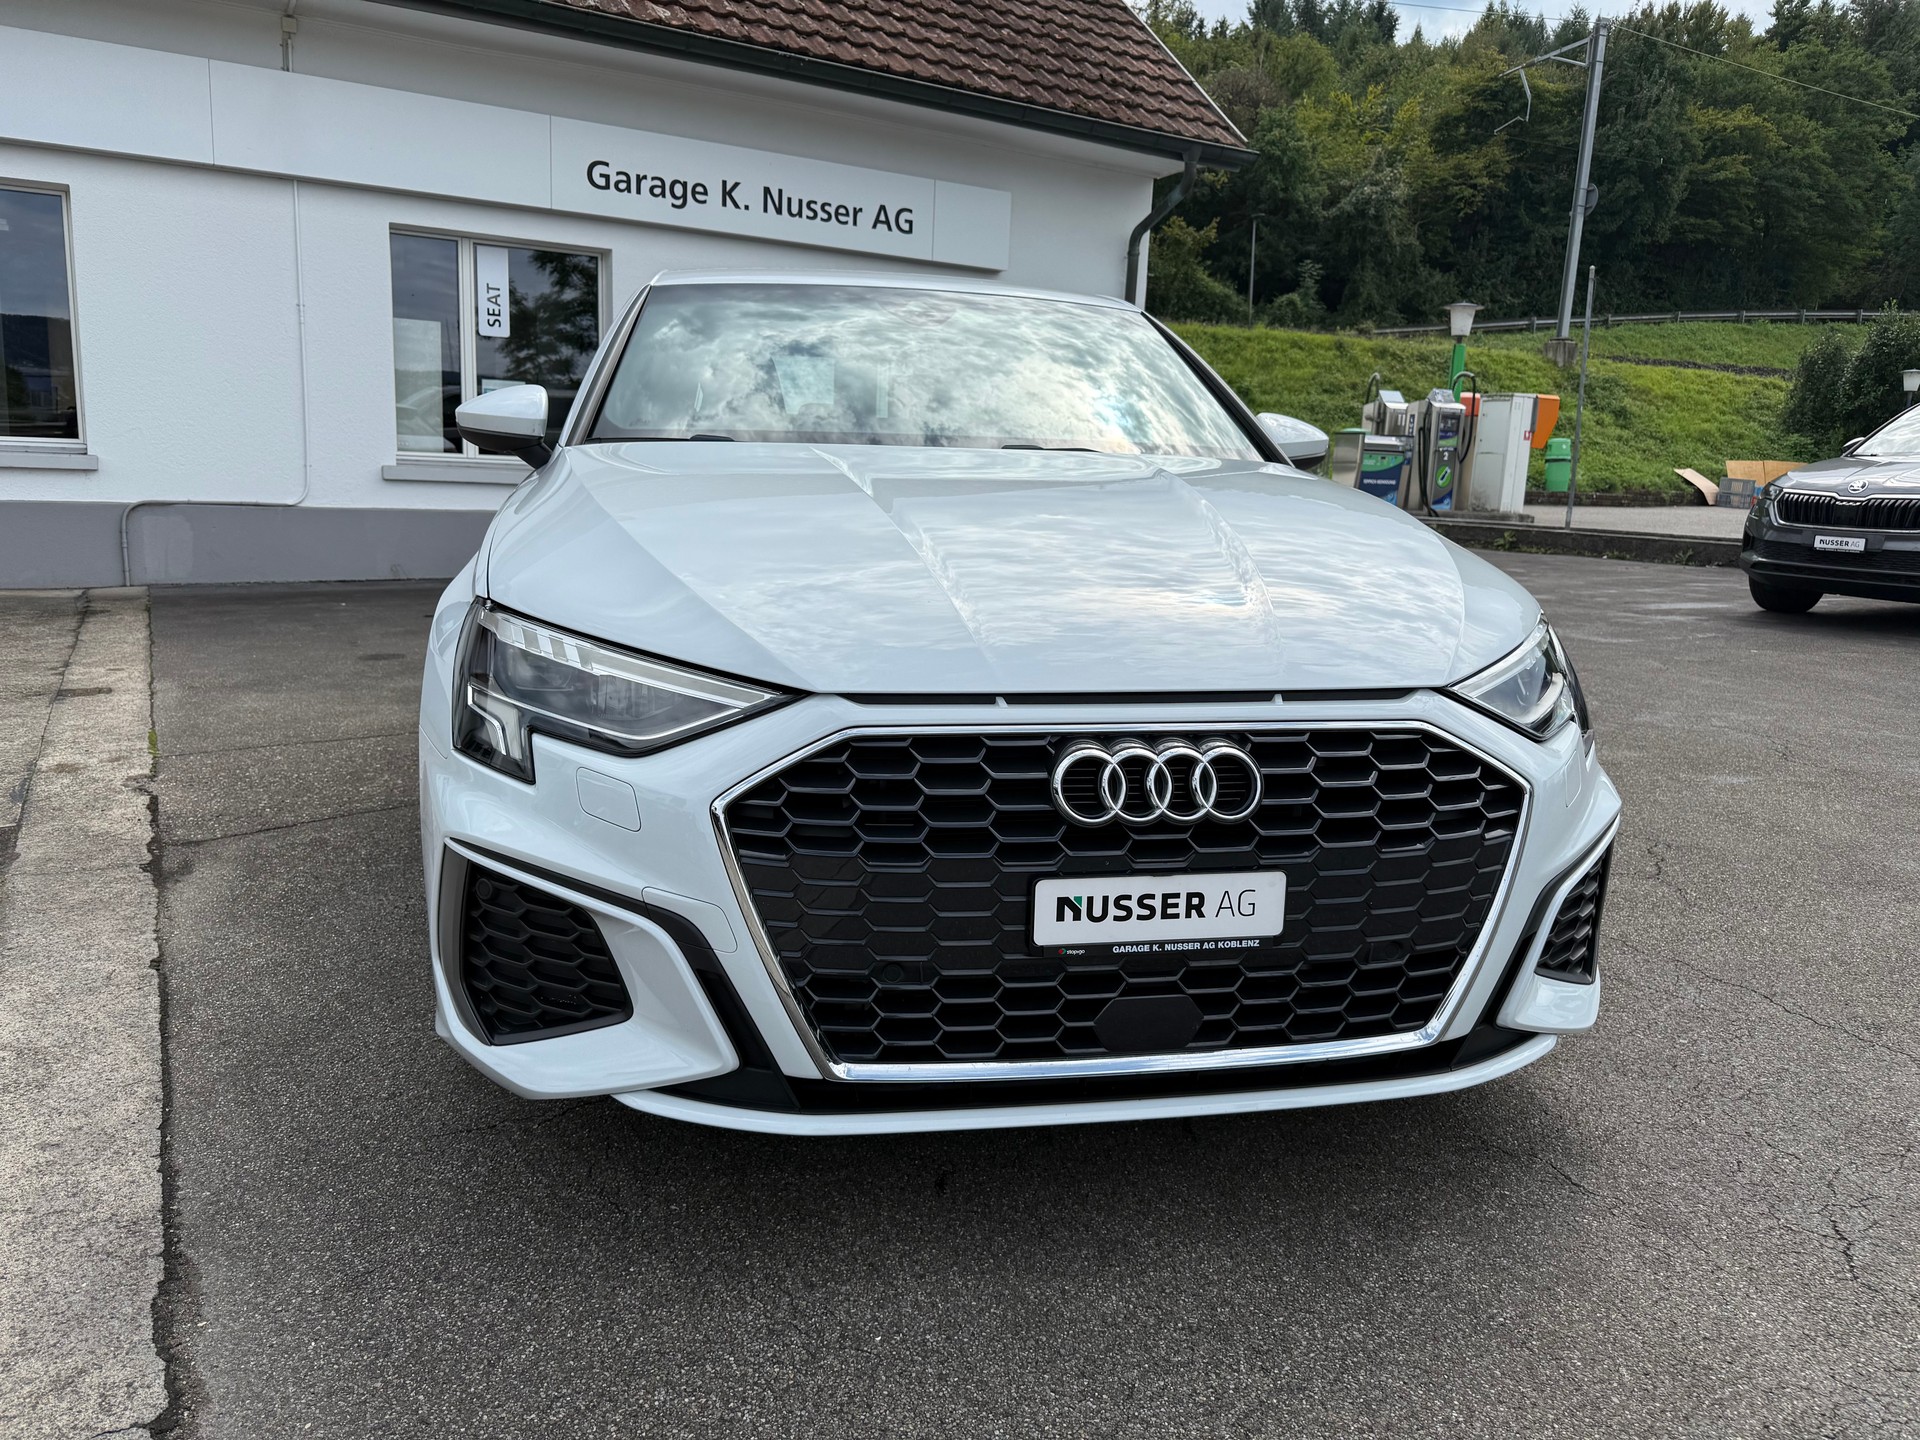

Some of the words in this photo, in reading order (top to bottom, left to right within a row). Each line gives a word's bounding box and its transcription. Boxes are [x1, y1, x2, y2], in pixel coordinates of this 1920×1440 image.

[586, 160, 709, 209] Garage
[721, 180, 750, 211] K.
[762, 186, 863, 227] Nusser
[872, 203, 915, 235] AG
[486, 283, 501, 327] SEAT
[1819, 539, 1849, 547] NUSSER
[1055, 892, 1206, 923] NUSSER
[1215, 889, 1257, 918] AG
[1112, 944, 1151, 954] GARAGE
[1152, 943, 1163, 952] K.
[1164, 942, 1201, 951] NUSSER
[1202, 941, 1216, 950] AG
[1217, 940, 1260, 949] KOBLENZ
